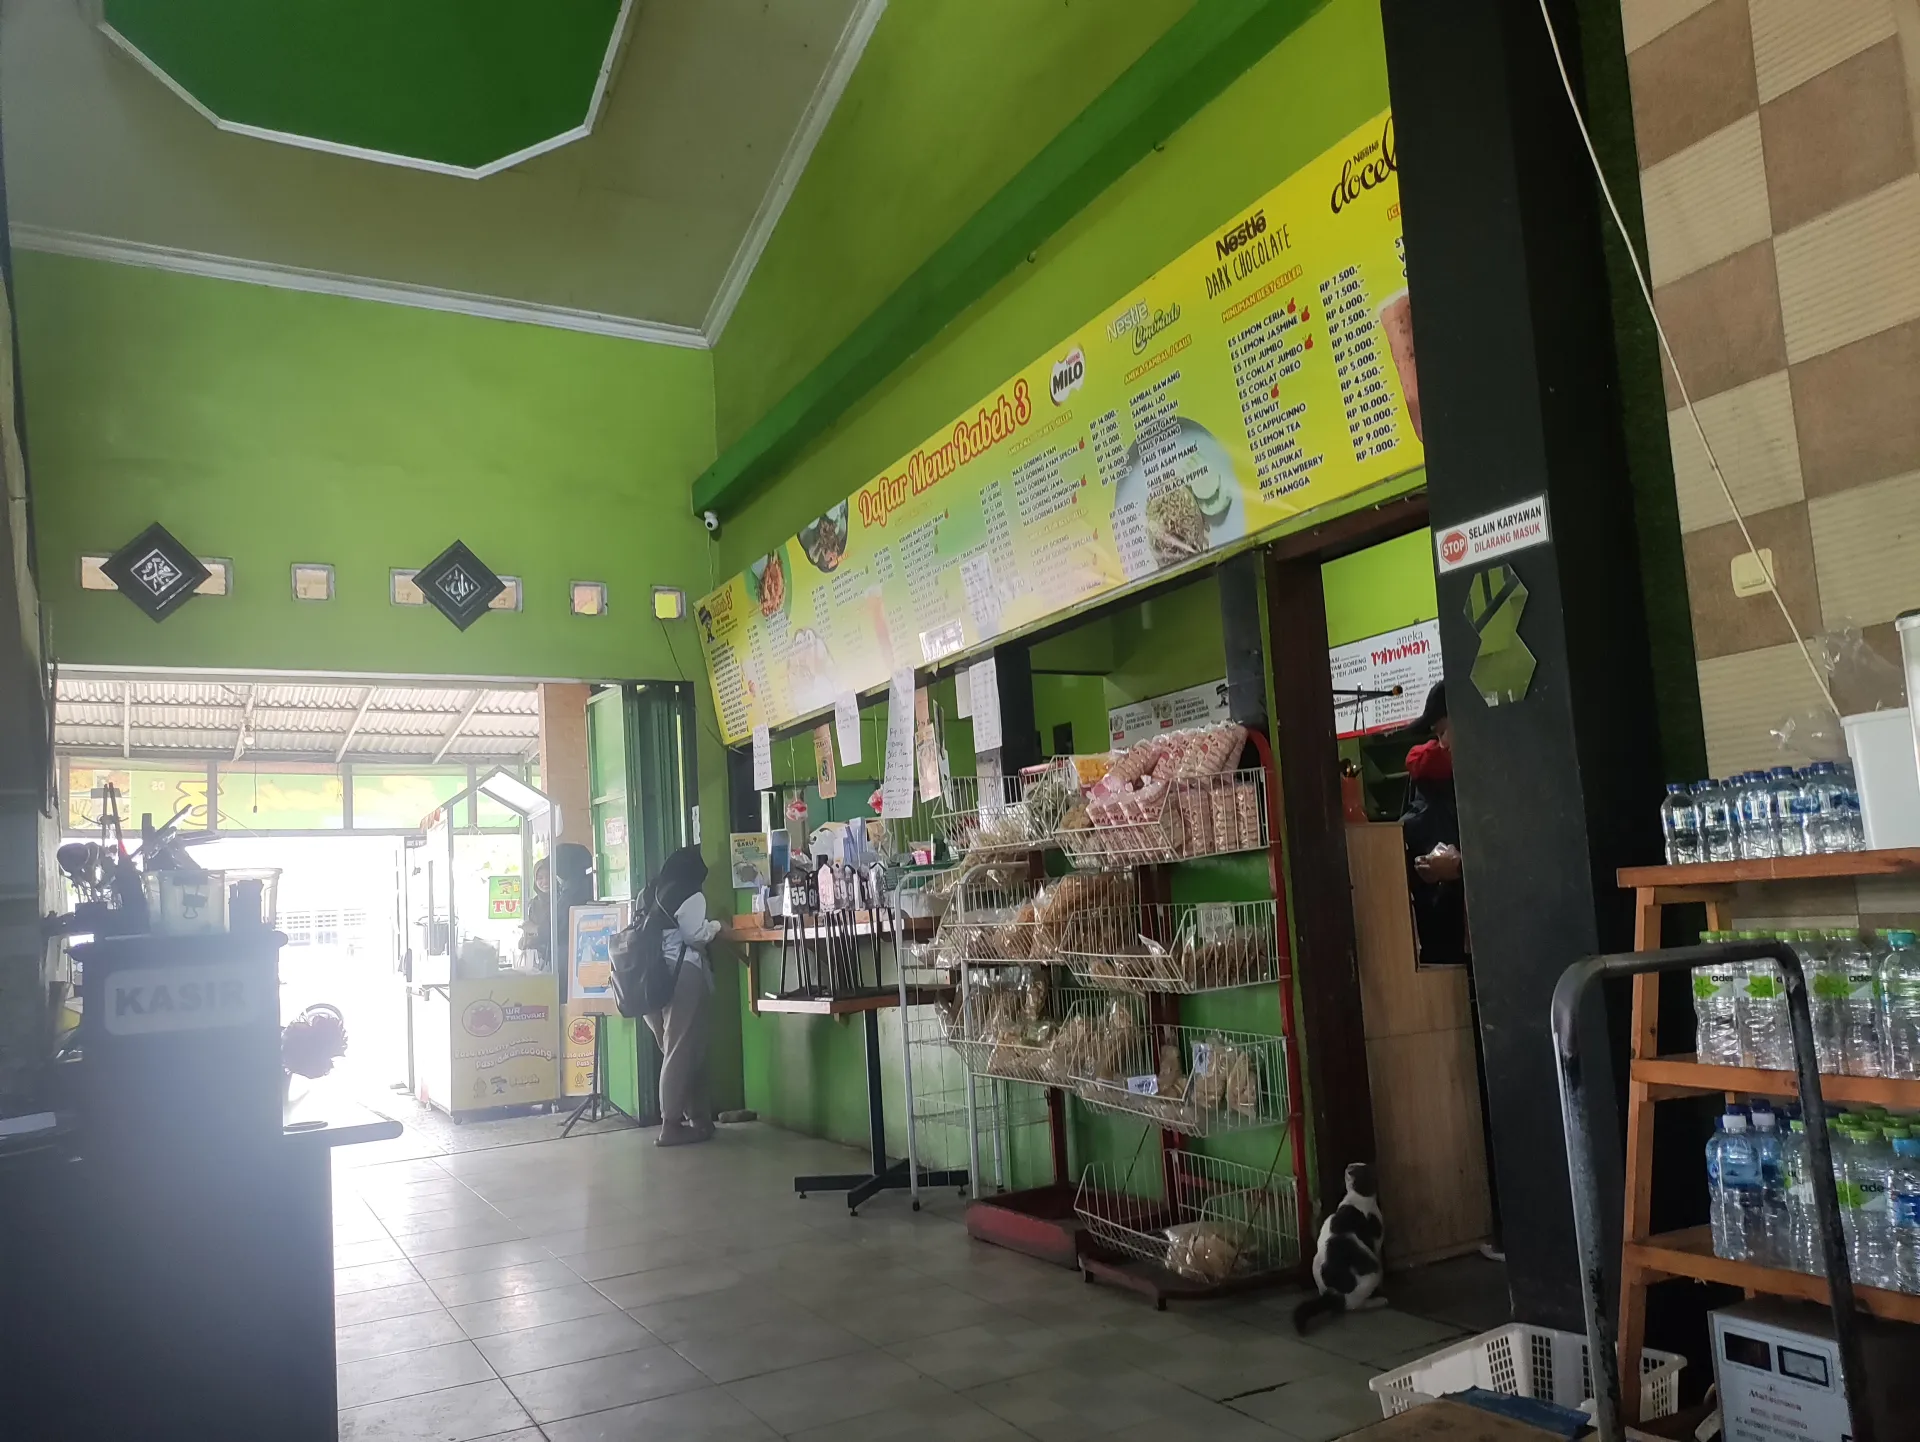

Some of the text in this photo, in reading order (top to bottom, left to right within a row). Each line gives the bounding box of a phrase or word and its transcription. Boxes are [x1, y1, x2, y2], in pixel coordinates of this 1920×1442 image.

[1331, 116, 1398, 214] docel
[1204, 224, 1291, 301] DARK CHOCOLATE
[1318, 264, 1361, 294] RP 7.500,-
[1321, 279, 1364, 308] RP 7.500,-
[1221, 264, 1303, 324] MINUMAN BEST SELLER
[1324, 293, 1369, 322] RP 6.000,-
[1227, 309, 1285, 349] ES LEMON CERIA
[1328, 307, 1371, 336] RP 7.500,-
[1330, 319, 1379, 350] RP 10.000,-
[1229, 315, 1298, 361] ES LEMON JASMINE
[1333, 336, 1378, 364] RP 5.000,-
[1232, 339, 1283, 375] ES TEH JUMBO
[1235, 343, 1303, 388] ES COKLAT JUMBO
[1337, 351, 1381, 378] RP 5.000,-
[1051, 362, 1083, 395] MILO
[1128, 371, 1180, 408] SAMBAL BAWANG
[1238, 360, 1301, 400] ES COKLAT OREO
[1340, 365, 1384, 393] RP 4.500,-
[1342, 379, 1387, 407] RP 4.500,-
[1131, 393, 1165, 420] SAMBAL IJO
[1133, 400, 1178, 432] SAMBAL MATAH
[1240, 393, 1269, 413] ES MILO
[1243, 402, 1279, 426] ES KUWUT
[1345, 393, 1395, 420] RP 10.000,-
[1136, 415, 1176, 443] SAMBAL GAMI
[1246, 403, 1306, 439] ES CAPPUCINNO
[1348, 407, 1398, 435] RP 10.000,-
[1138, 426, 1181, 454] SAUS PADANG
[1249, 422, 1301, 453] ES LEMON TEA
[1352, 423, 1397, 449] RP 9.000,-
[1355, 438, 1400, 463] RP 7.000,-
[859, 474, 907, 528] Daftar
[908, 442, 955, 496] Menu
[953, 395, 1015, 466] Babeh
[1014, 378, 1031, 425] 3
[1011, 446, 1057, 477] NASI GORENG AYAM
[1013, 446, 1078, 487] NASI GORENG AYAM SPECIAL
[1140, 442, 1177, 466] SAUS TIRAM
[1143, 444, 1198, 478] SAUS ASAM MANIS
[1253, 439, 1295, 465] JUS DURIAN
[1255, 448, 1303, 478] JUS ALPUKAT
[1015, 469, 1058, 497] NASI GORENG KARI
[1146, 468, 1175, 489] SAUS BBQ
[1148, 466, 1209, 502] SAUS BLACK PEPPER
[1258, 454, 1324, 491] JUS STRAWBERRY
[1018, 478, 1063, 507] NASI GORENG JAWA
[1020, 481, 1080, 517] NASI GORENG HONGKONG
[1262, 476, 1310, 503] JUS MANGGA
[1022, 498, 1070, 528] NASI GORENG BAKSO
[1468, 506, 1541, 541] SELAIN KARYAWAN
[1442, 538, 1464, 558] STOP
[1473, 523, 1541, 554] DILARANG MASUK
[1396, 630, 1423, 646] aneka
[1330, 658, 1367, 672] YAM GORENG
[1370, 639, 1430, 668] minuman
[1346, 666, 1367, 677] JUMBO
[491, 900, 520, 913] TU
[790, 886, 807, 907] 55
[1711, 974, 1733, 983] ades
[115, 981, 247, 1016] KASIR
[1859, 1182, 1884, 1194] ade
